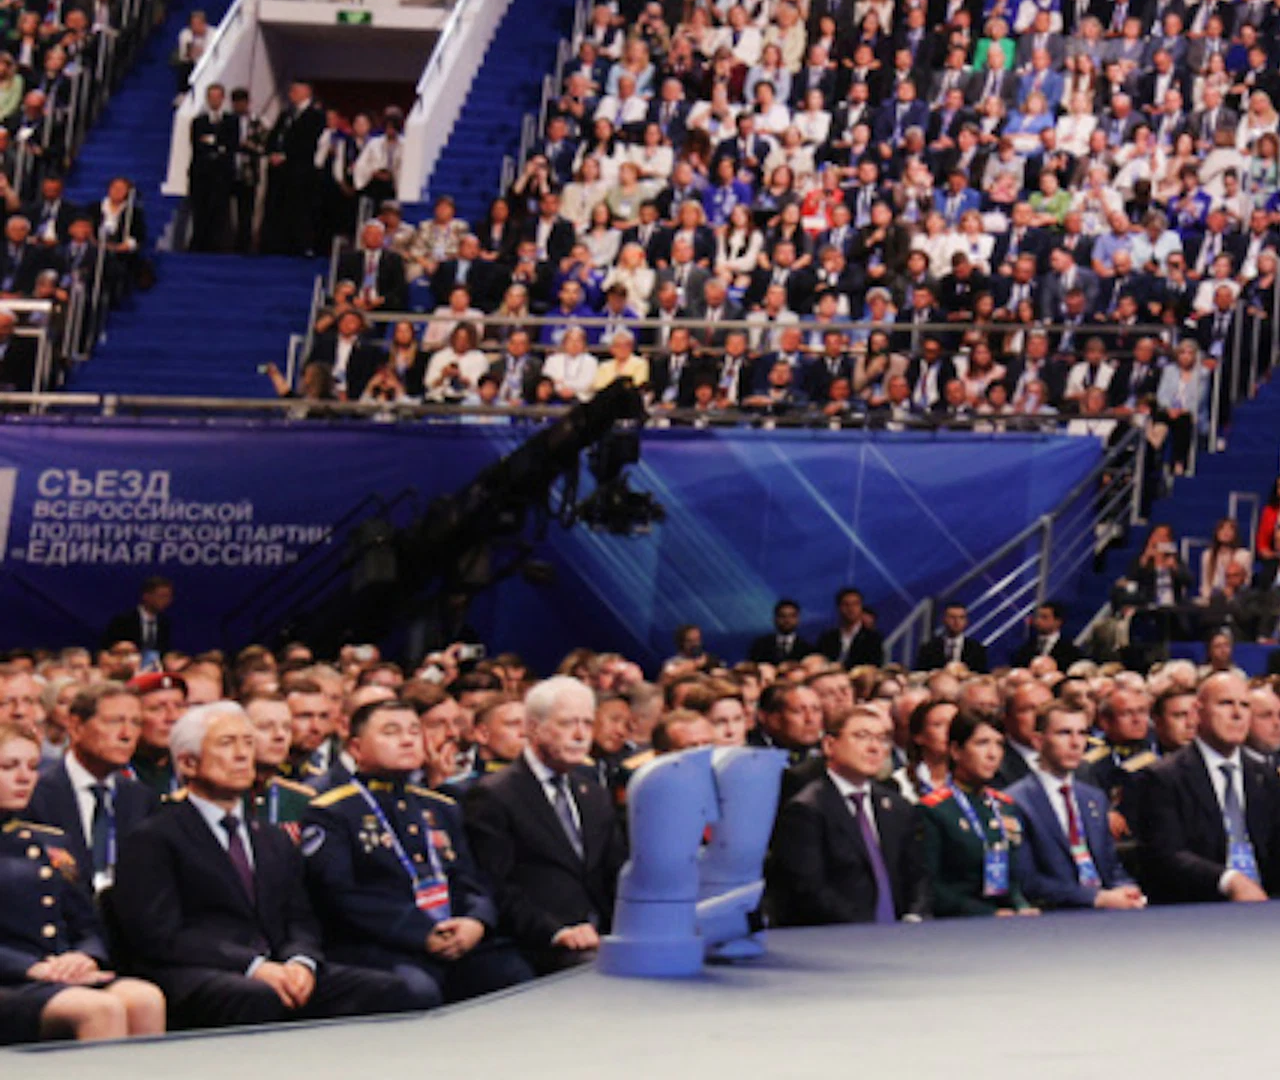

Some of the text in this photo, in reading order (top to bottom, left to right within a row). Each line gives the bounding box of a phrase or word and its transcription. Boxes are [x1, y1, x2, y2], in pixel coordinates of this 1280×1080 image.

[37, 469, 171, 501] СЪЕЗД
[33, 498, 254, 522] ВСЕРОССИЙСКОЙ
[29, 520, 231, 543] ПОЛИТИЧЕСКОЙ
[11, 541, 298, 567] «ЕДИНАЯ РОССИЯ»
